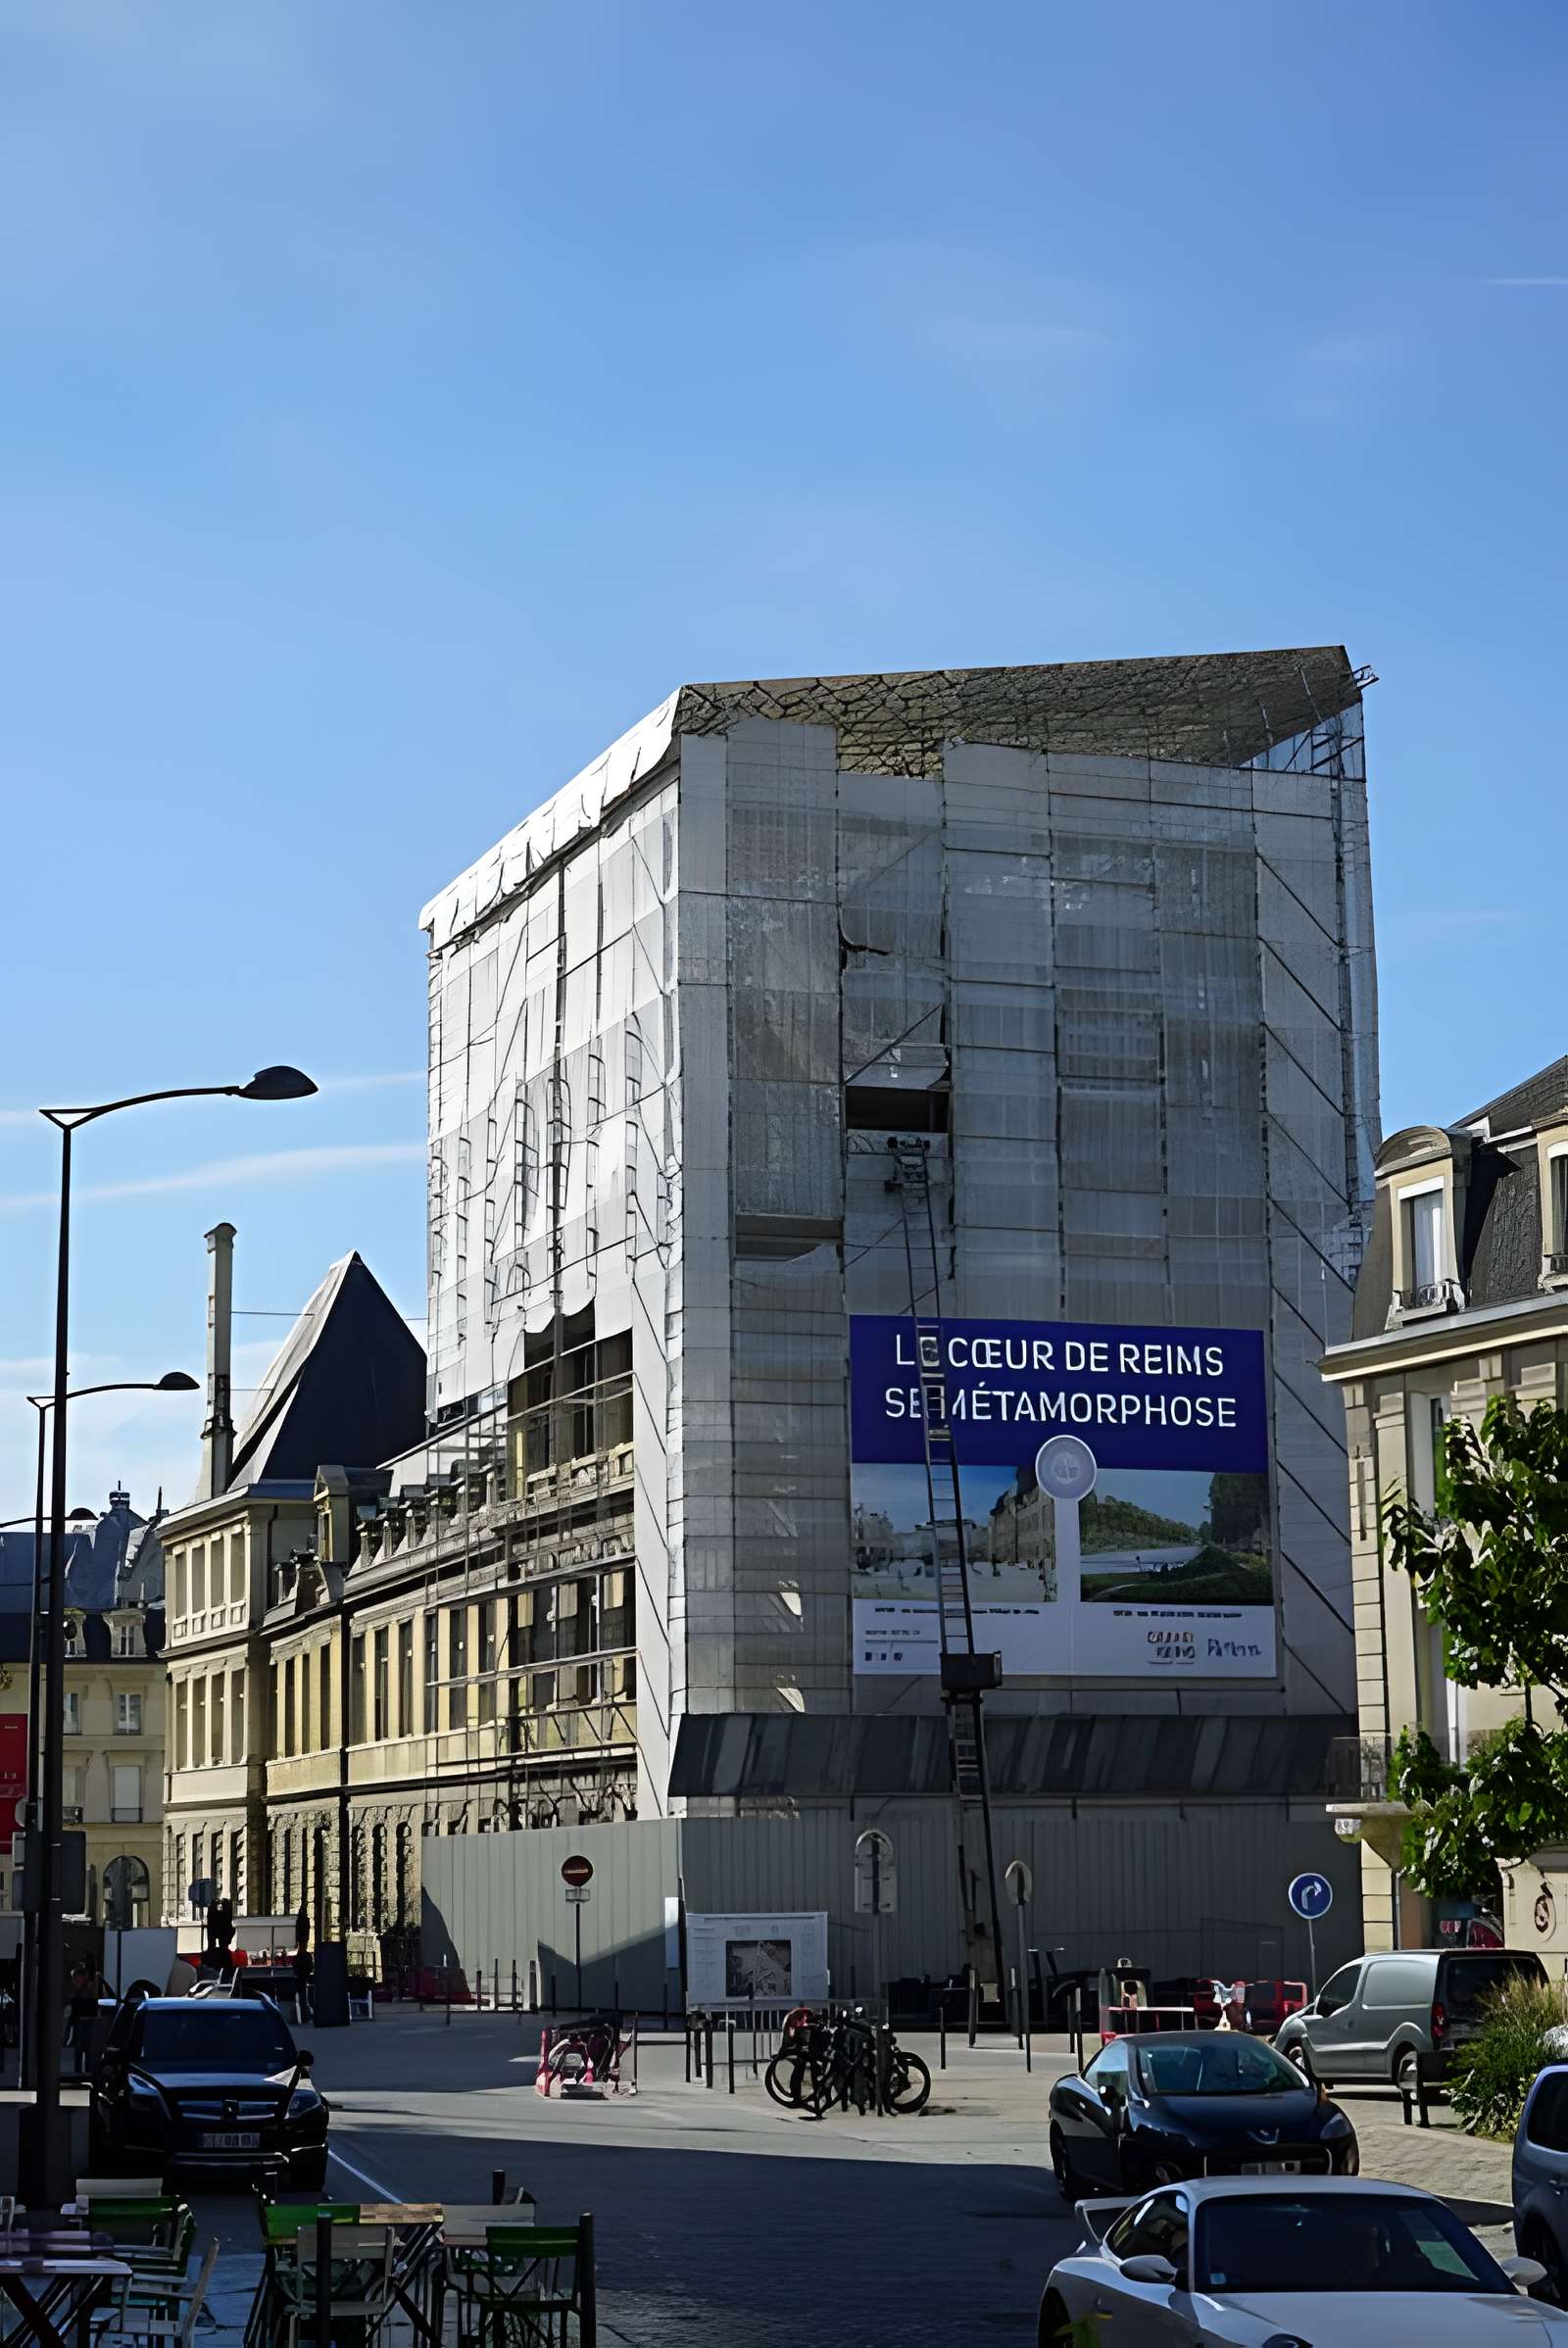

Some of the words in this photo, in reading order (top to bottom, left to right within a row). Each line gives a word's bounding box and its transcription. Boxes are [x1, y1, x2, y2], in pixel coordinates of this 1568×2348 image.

[1065, 1341, 1109, 1373] DE
[1119, 1343, 1224, 1377] REIMS
[885, 1387, 922, 1419] SE
[940, 1381, 1237, 1428] MÉTAMORPHOSE
